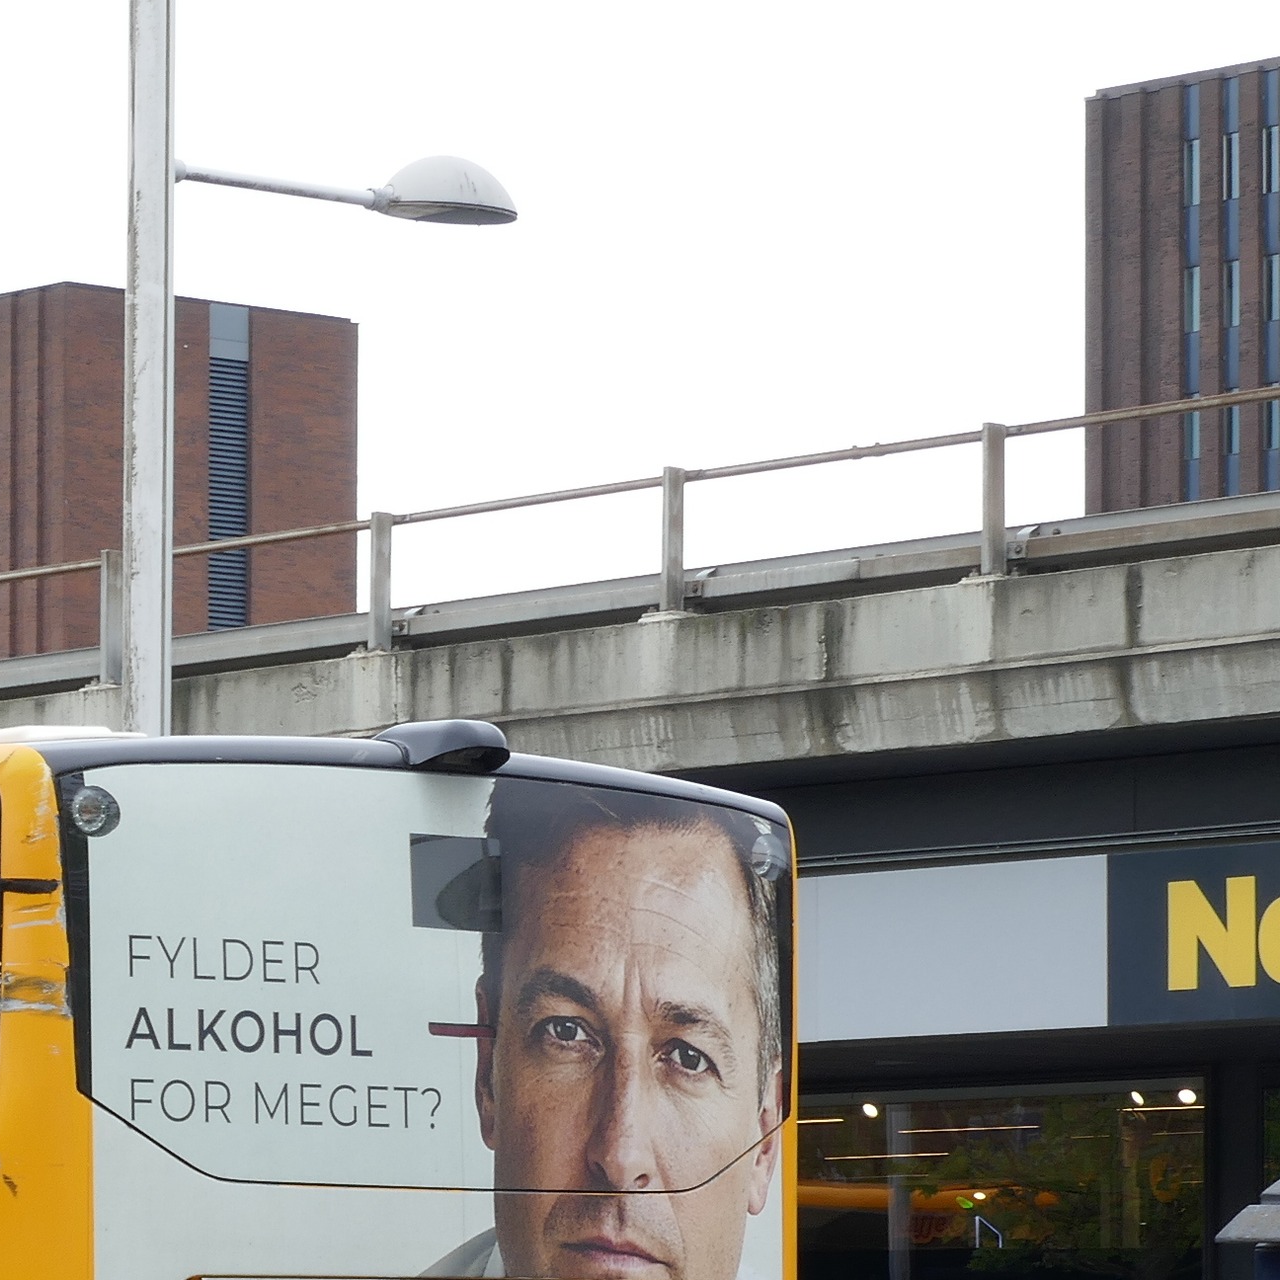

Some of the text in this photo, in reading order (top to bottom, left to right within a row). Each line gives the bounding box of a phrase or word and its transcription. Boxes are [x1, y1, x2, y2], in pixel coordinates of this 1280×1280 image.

[126, 934, 321, 985] FYLDER
[125, 1006, 373, 1058] ALKOHOL
[129, 1078, 442, 1130] FOR MEGET?
